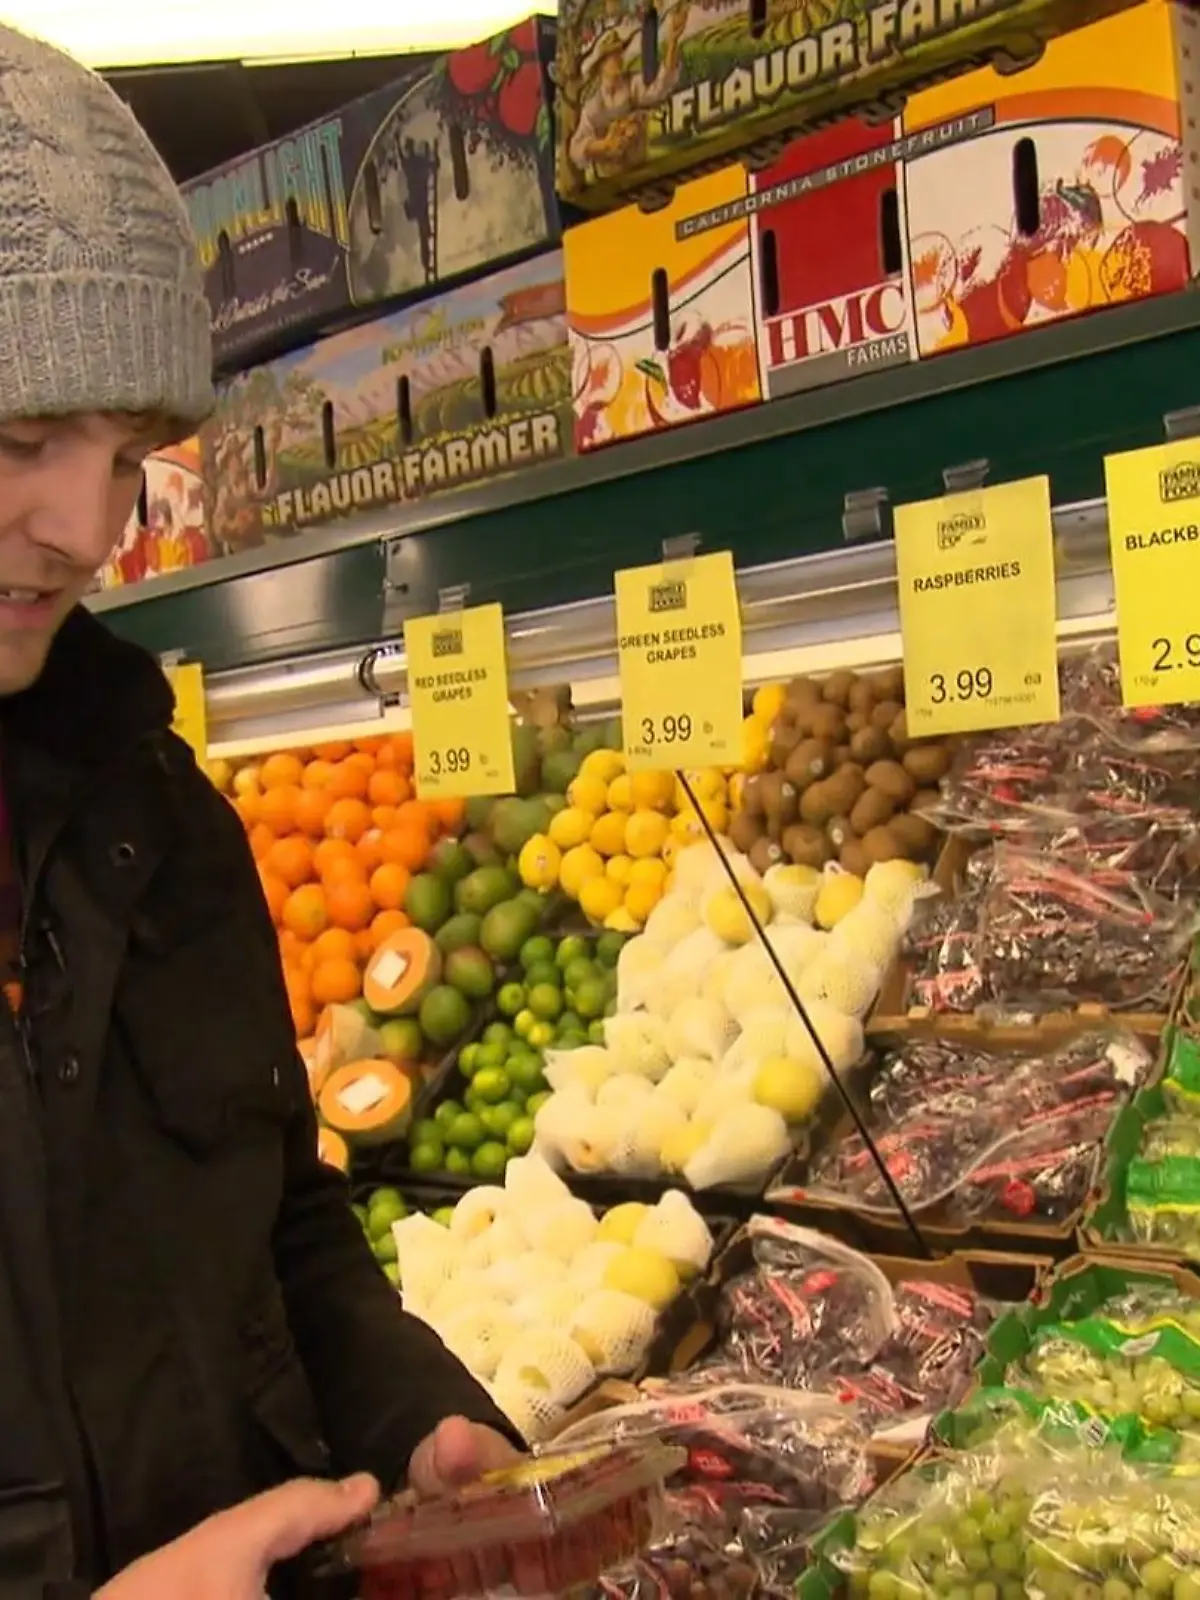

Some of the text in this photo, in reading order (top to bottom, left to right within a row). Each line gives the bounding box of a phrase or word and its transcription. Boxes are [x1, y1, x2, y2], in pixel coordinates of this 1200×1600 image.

[672, 0, 996, 133] FLAVOR FAR
[683, 114, 982, 234] CALIFORNIA STONEFRUIT
[767, 284, 906, 366] HMC
[847, 338, 908, 367] FARMS
[276, 414, 558, 525] FLAVOR FARMER
[1125, 524, 1200, 551] BLACKB
[912, 561, 1021, 592] RASPBERRIES
[620, 623, 725, 650] GREEN SEEDLESS
[646, 645, 697, 664] GRAPES
[415, 668, 488, 689] RED SEEDLESS
[930, 667, 993, 704] 3.99
[432, 686, 473, 703] GRAPES
[641, 713, 692, 745] 3.99
[429, 747, 471, 775] 3.99
